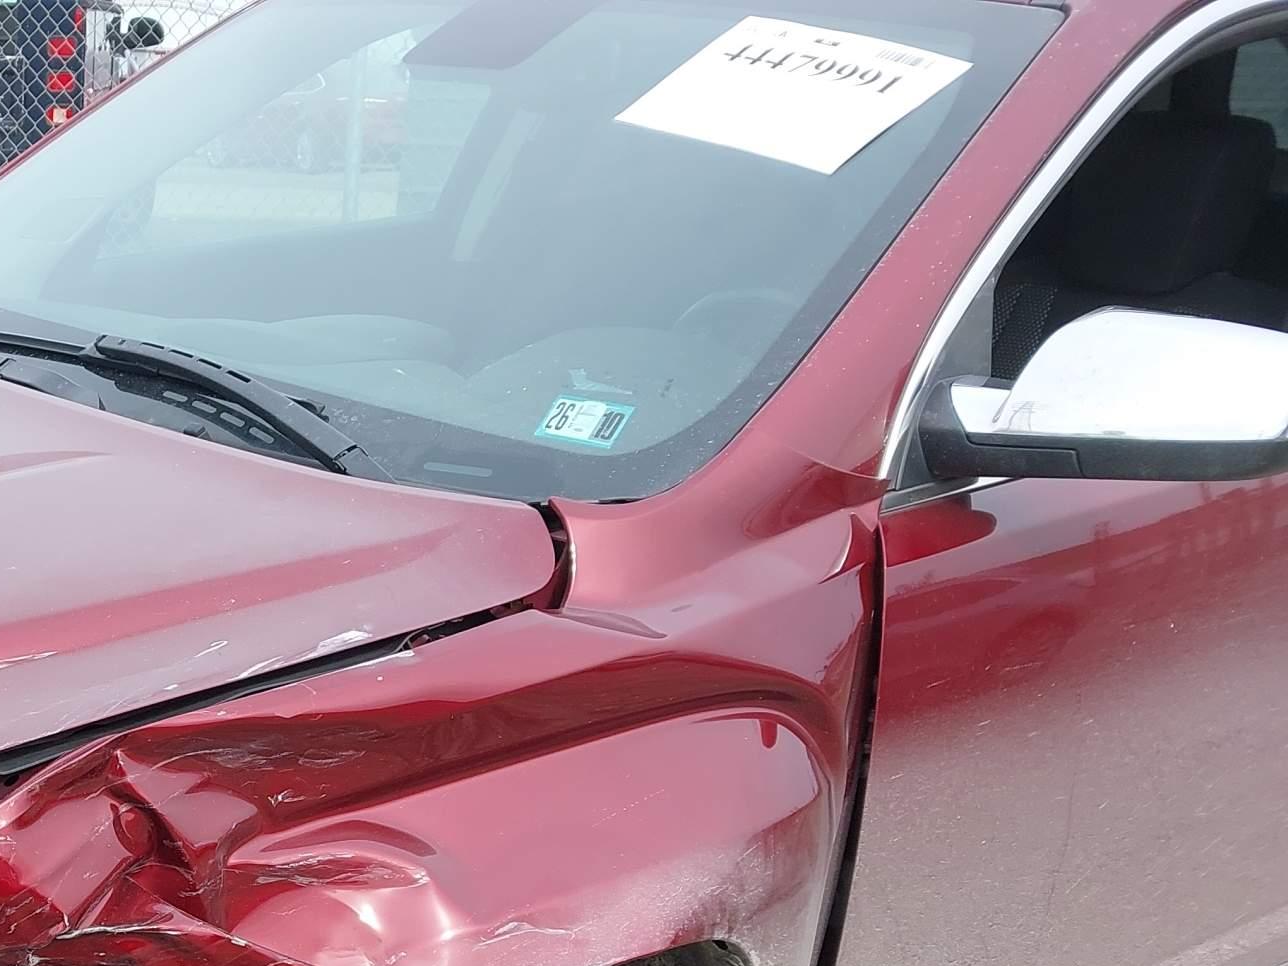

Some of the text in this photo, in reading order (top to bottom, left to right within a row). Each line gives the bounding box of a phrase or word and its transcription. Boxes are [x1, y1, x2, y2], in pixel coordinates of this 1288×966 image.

[723, 44, 903, 93] 44479991
[545, 401, 626, 440] 26 10
